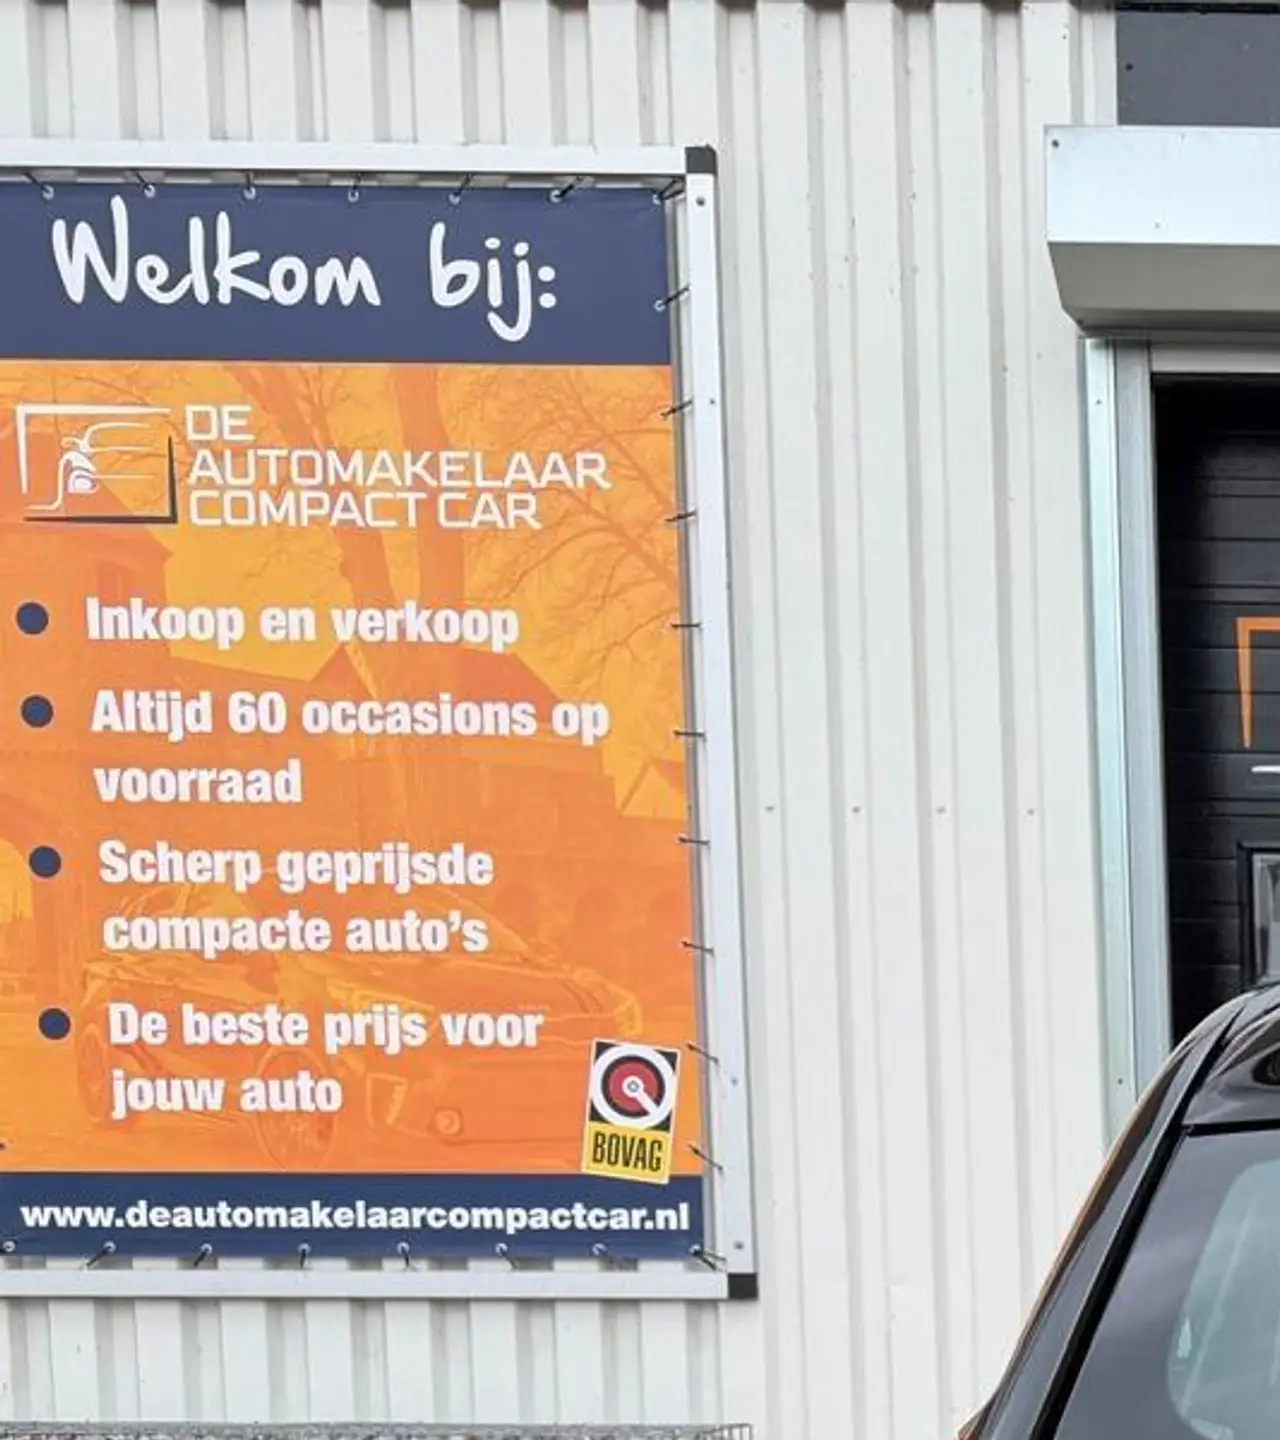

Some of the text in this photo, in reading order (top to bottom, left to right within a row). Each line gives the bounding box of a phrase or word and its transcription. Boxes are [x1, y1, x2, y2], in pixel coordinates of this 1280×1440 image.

[52, 195, 557, 342] Welkom bij:
[185, 404, 254, 442] DE
[187, 448, 611, 490] AUTOMAKELAAR
[188, 490, 542, 530] COMPACT CAR
[86, 597, 519, 653] Inkoop en verkoop
[91, 689, 610, 746] Altijd 60 occasions op
[94, 759, 302, 804] voorraad
[99, 839, 494, 895] Scherp geprijsde
[103, 911, 489, 959] compacte auto’s
[108, 1002, 544, 1055] De beste prijs voor
[111, 1070, 344, 1120] jouw auto
[592, 1131, 663, 1172] BOVAG
[20, 1201, 691, 1234] www.deautomakelaarcompactcar.nl
